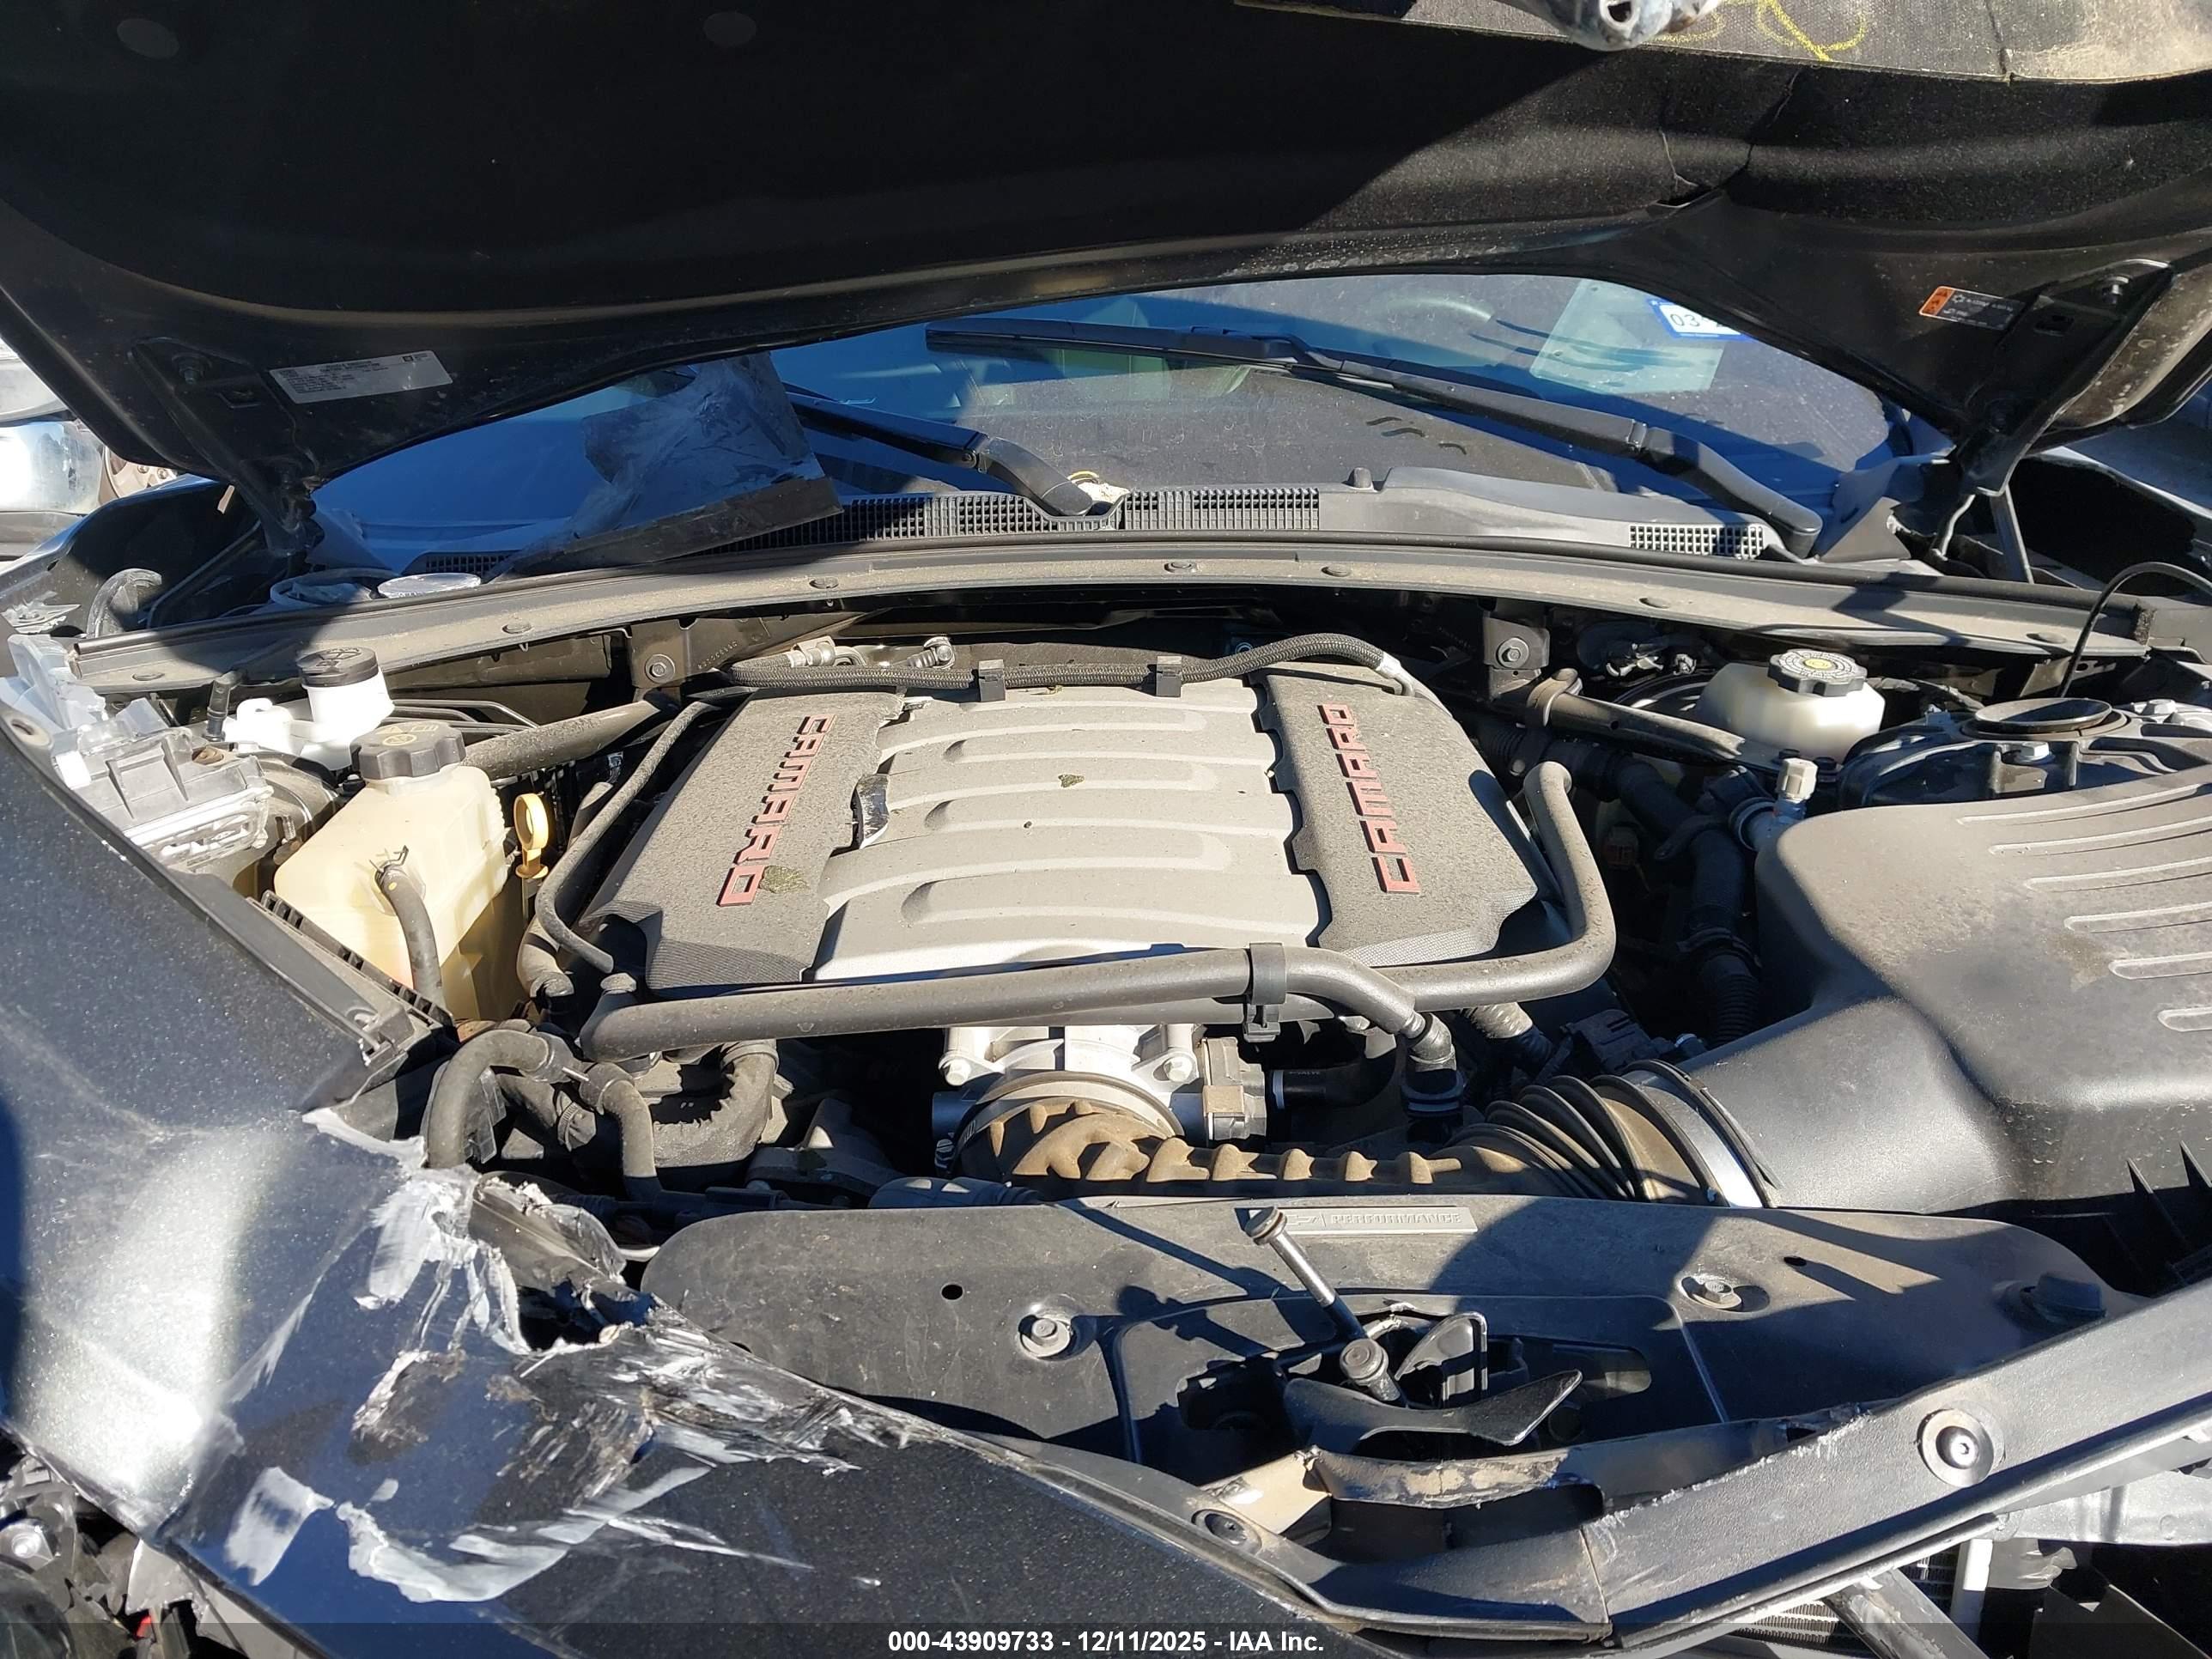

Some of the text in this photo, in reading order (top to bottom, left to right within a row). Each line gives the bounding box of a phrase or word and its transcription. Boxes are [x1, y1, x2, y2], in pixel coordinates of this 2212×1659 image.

[717, 714, 837, 907] CAMARO
[1317, 703, 1421, 895] CAMARO
[1332, 1212, 1462, 1224] PERFORMANCE
